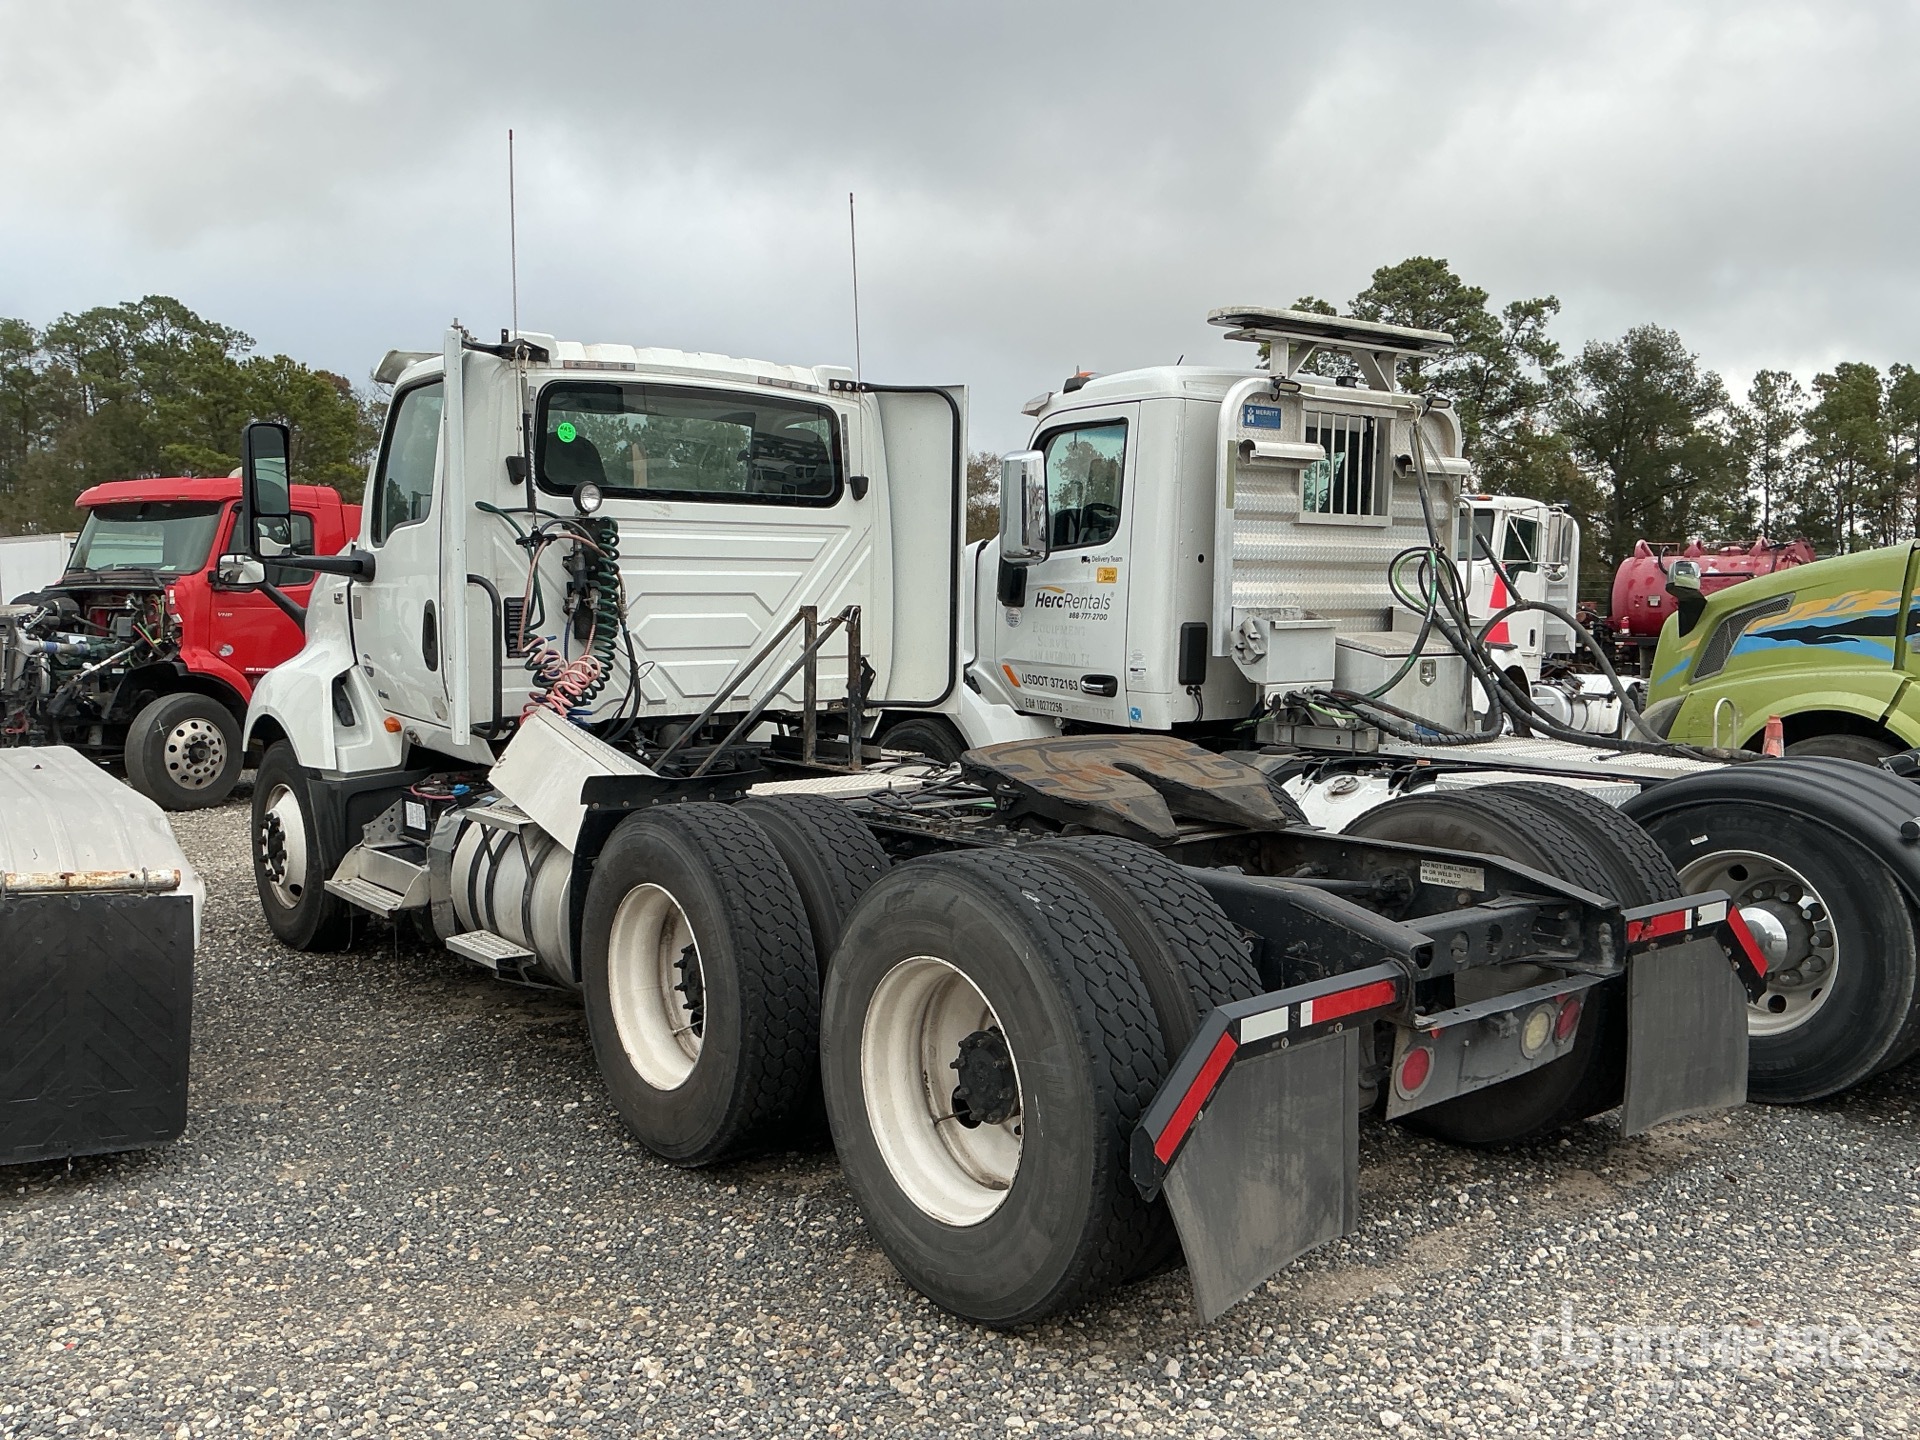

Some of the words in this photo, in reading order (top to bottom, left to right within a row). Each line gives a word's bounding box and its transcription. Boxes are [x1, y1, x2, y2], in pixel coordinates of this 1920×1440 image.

[1091, 555, 1110, 563] Delivery
[1022, 673, 1049, 687] USDOT
[1050, 677, 1078, 691] 372163
